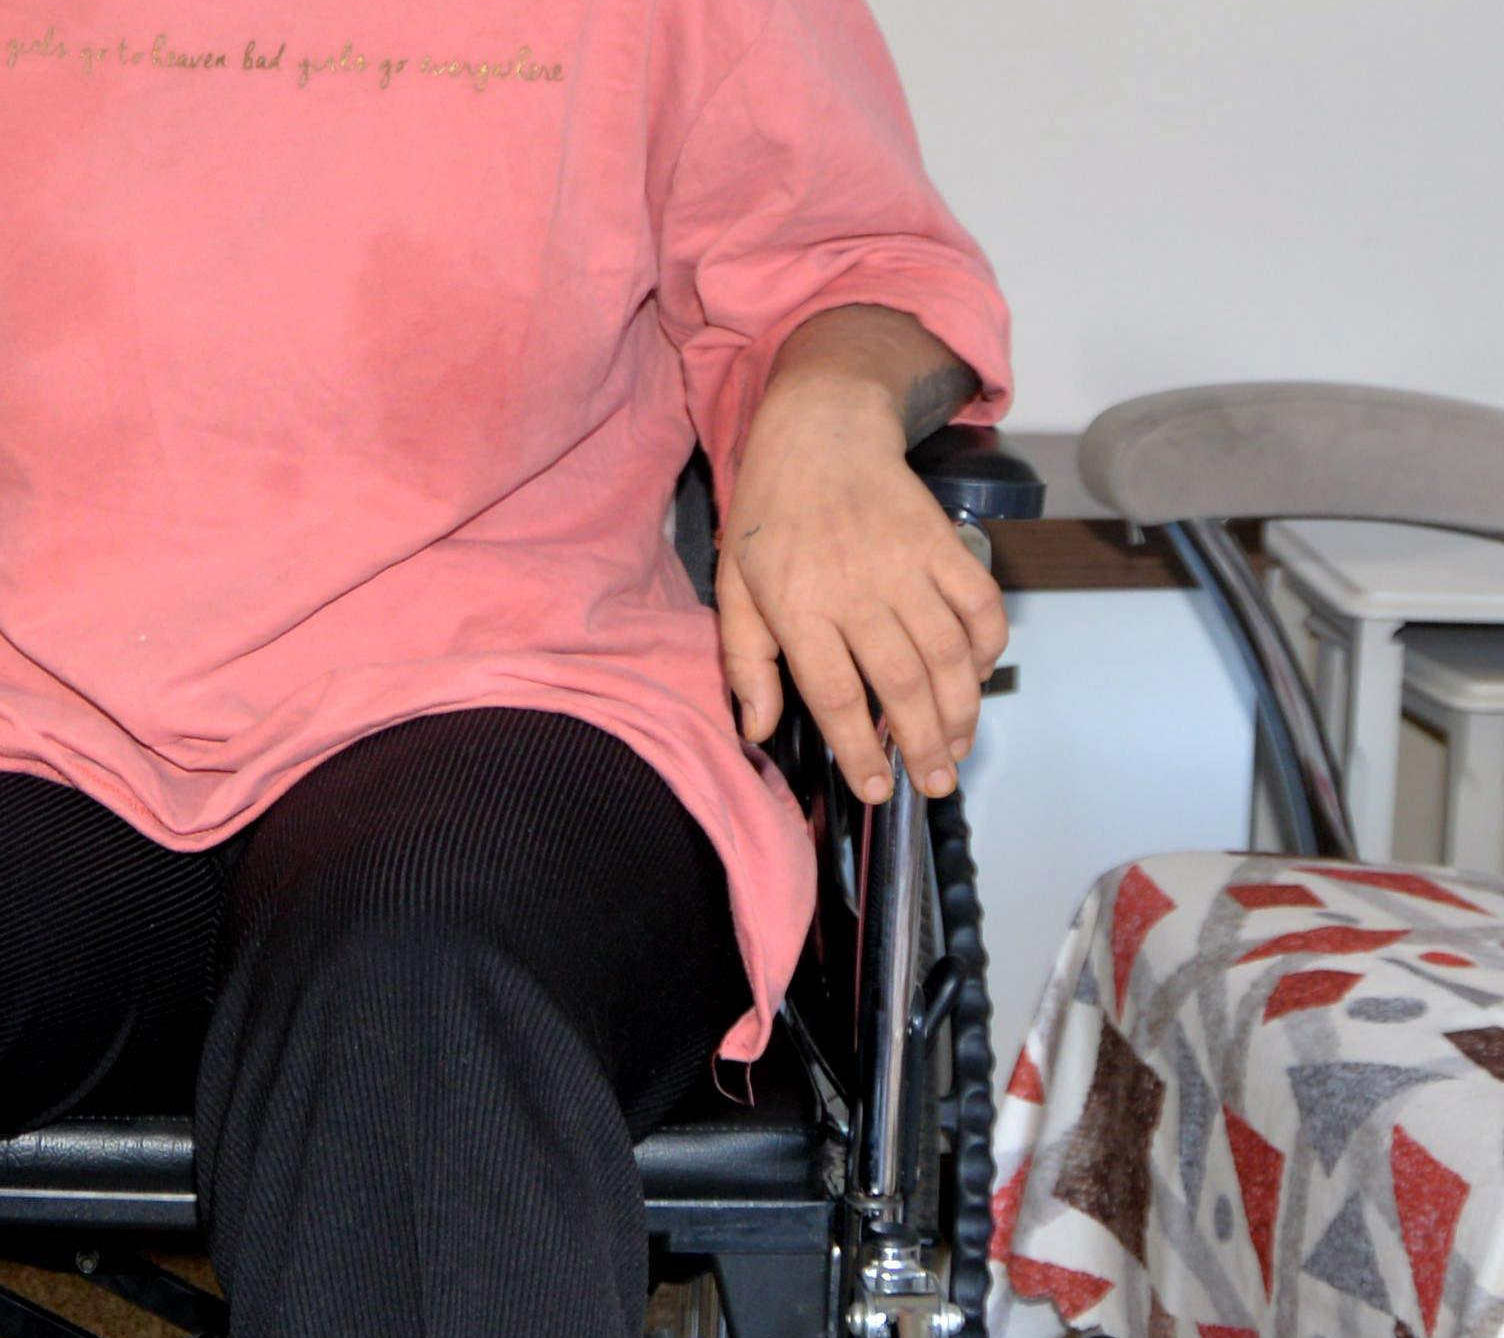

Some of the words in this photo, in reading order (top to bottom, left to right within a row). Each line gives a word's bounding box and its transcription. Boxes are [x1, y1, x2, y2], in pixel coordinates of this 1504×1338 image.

[80, 47, 109, 76] go
[117, 37, 145, 65] to
[151, 33, 226, 69] heaven
[242, 40, 286, 70] bad
[378, 58, 408, 91] go
[420, 45, 565, 92] everywhere
